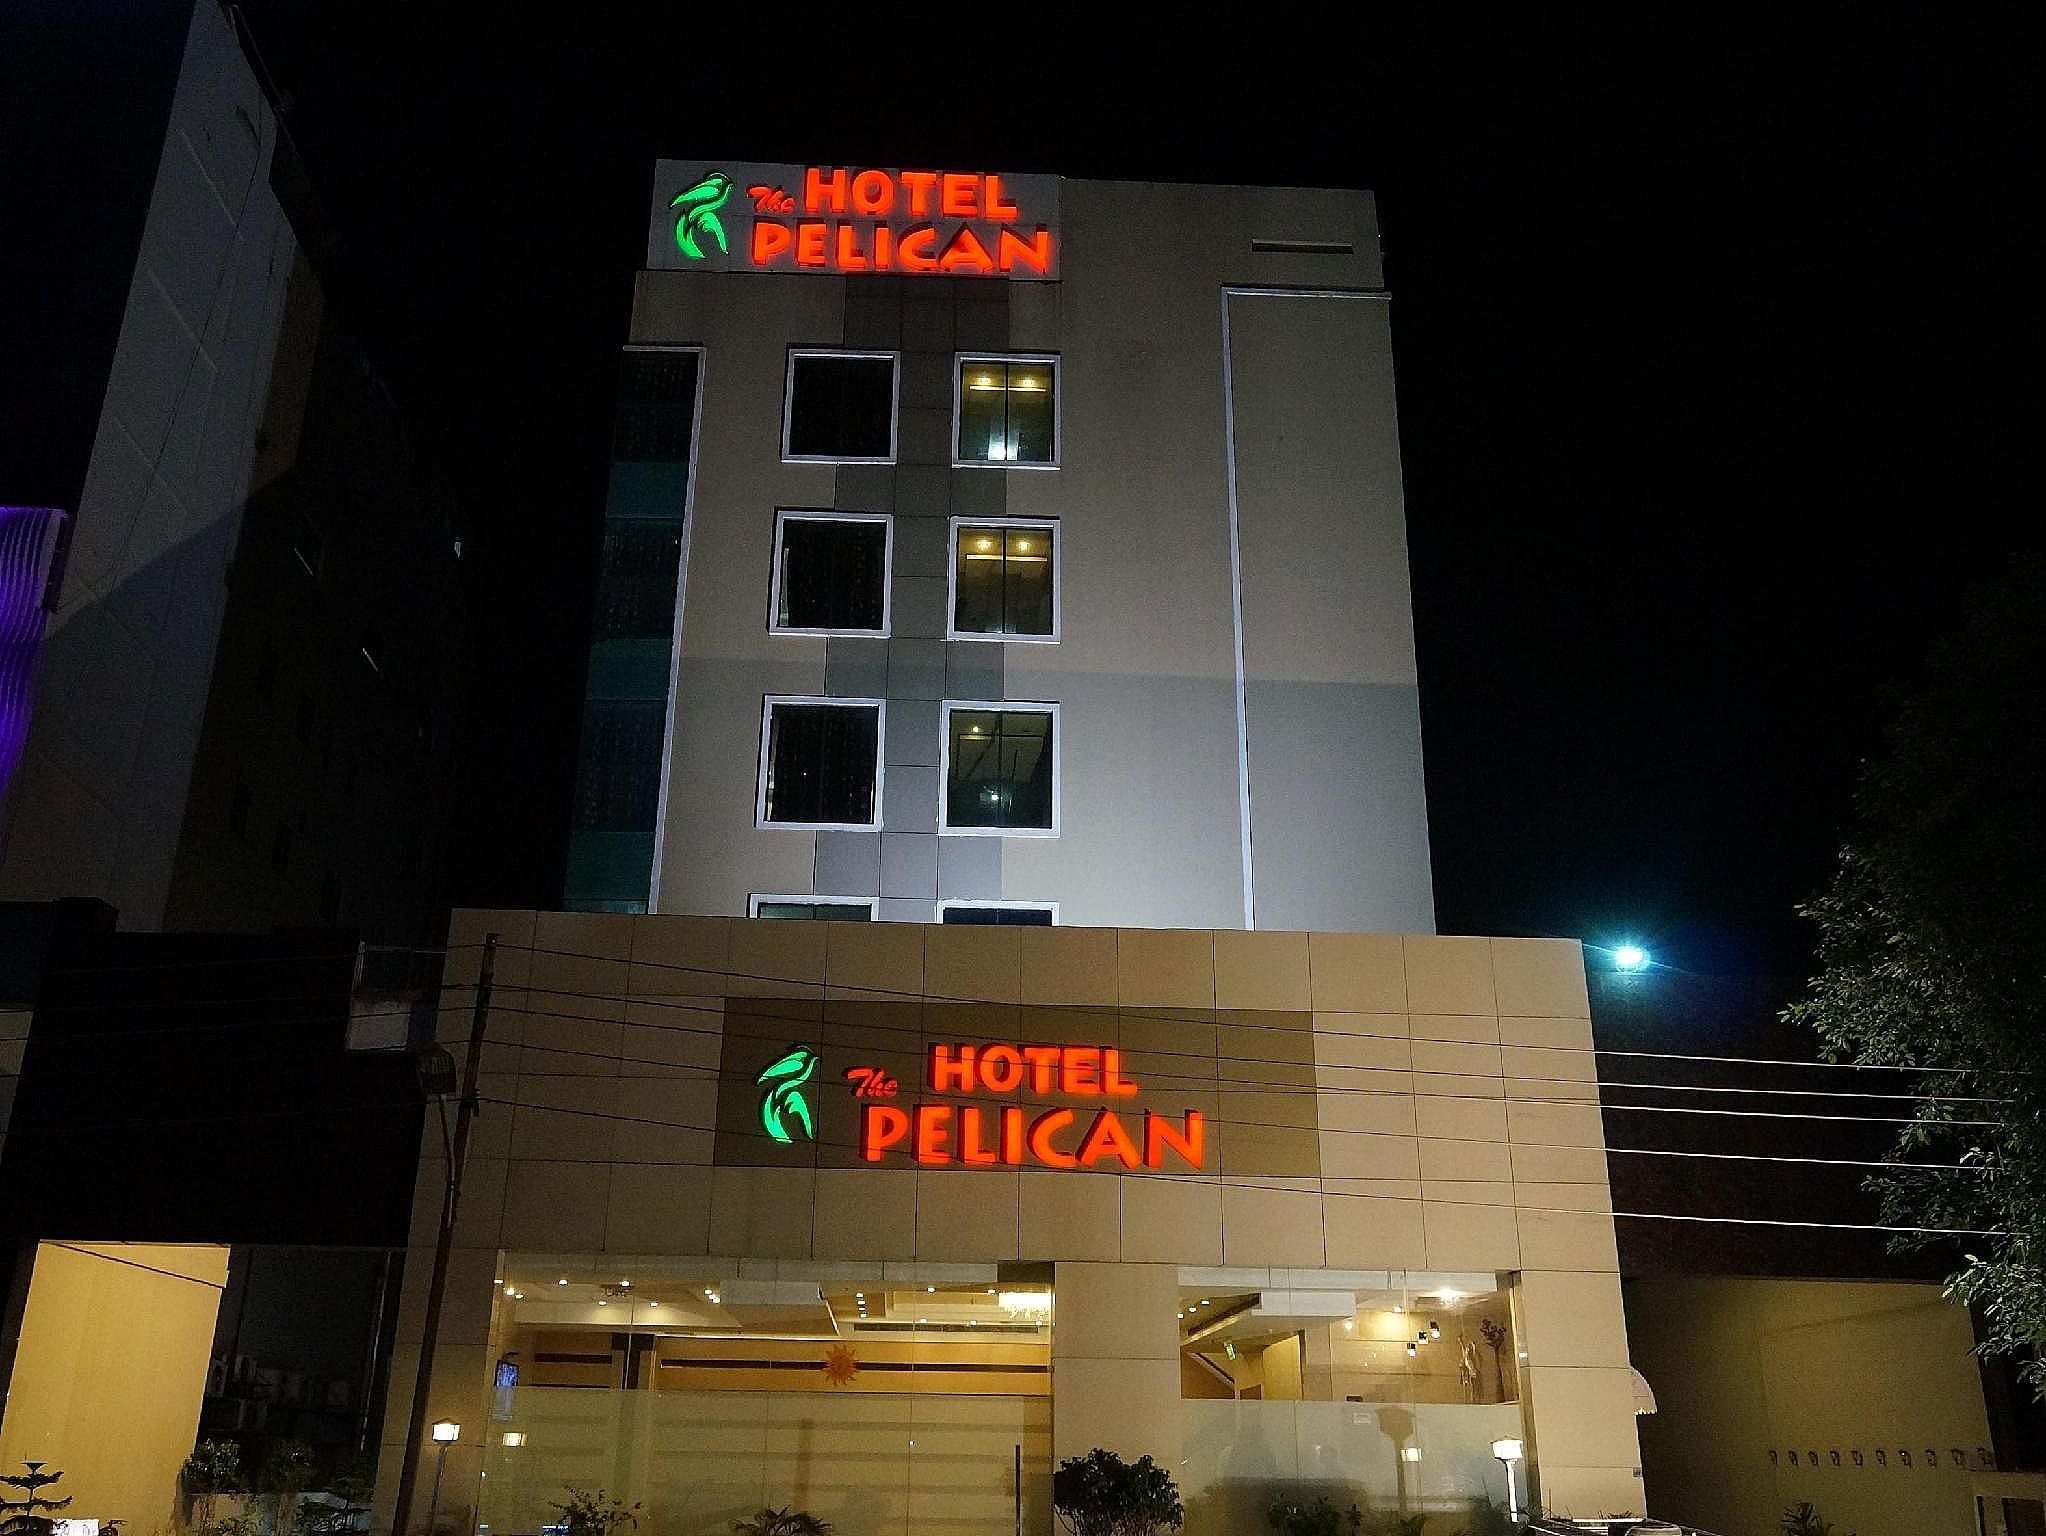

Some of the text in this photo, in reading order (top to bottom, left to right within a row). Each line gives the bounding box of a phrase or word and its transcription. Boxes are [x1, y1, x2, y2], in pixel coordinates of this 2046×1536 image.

[747, 167, 1019, 219] The HOTEL
[752, 219, 1049, 274] PELICAN
[846, 1044, 1138, 1098] The HOTEL
[862, 1104, 1203, 1169] PELICAN
